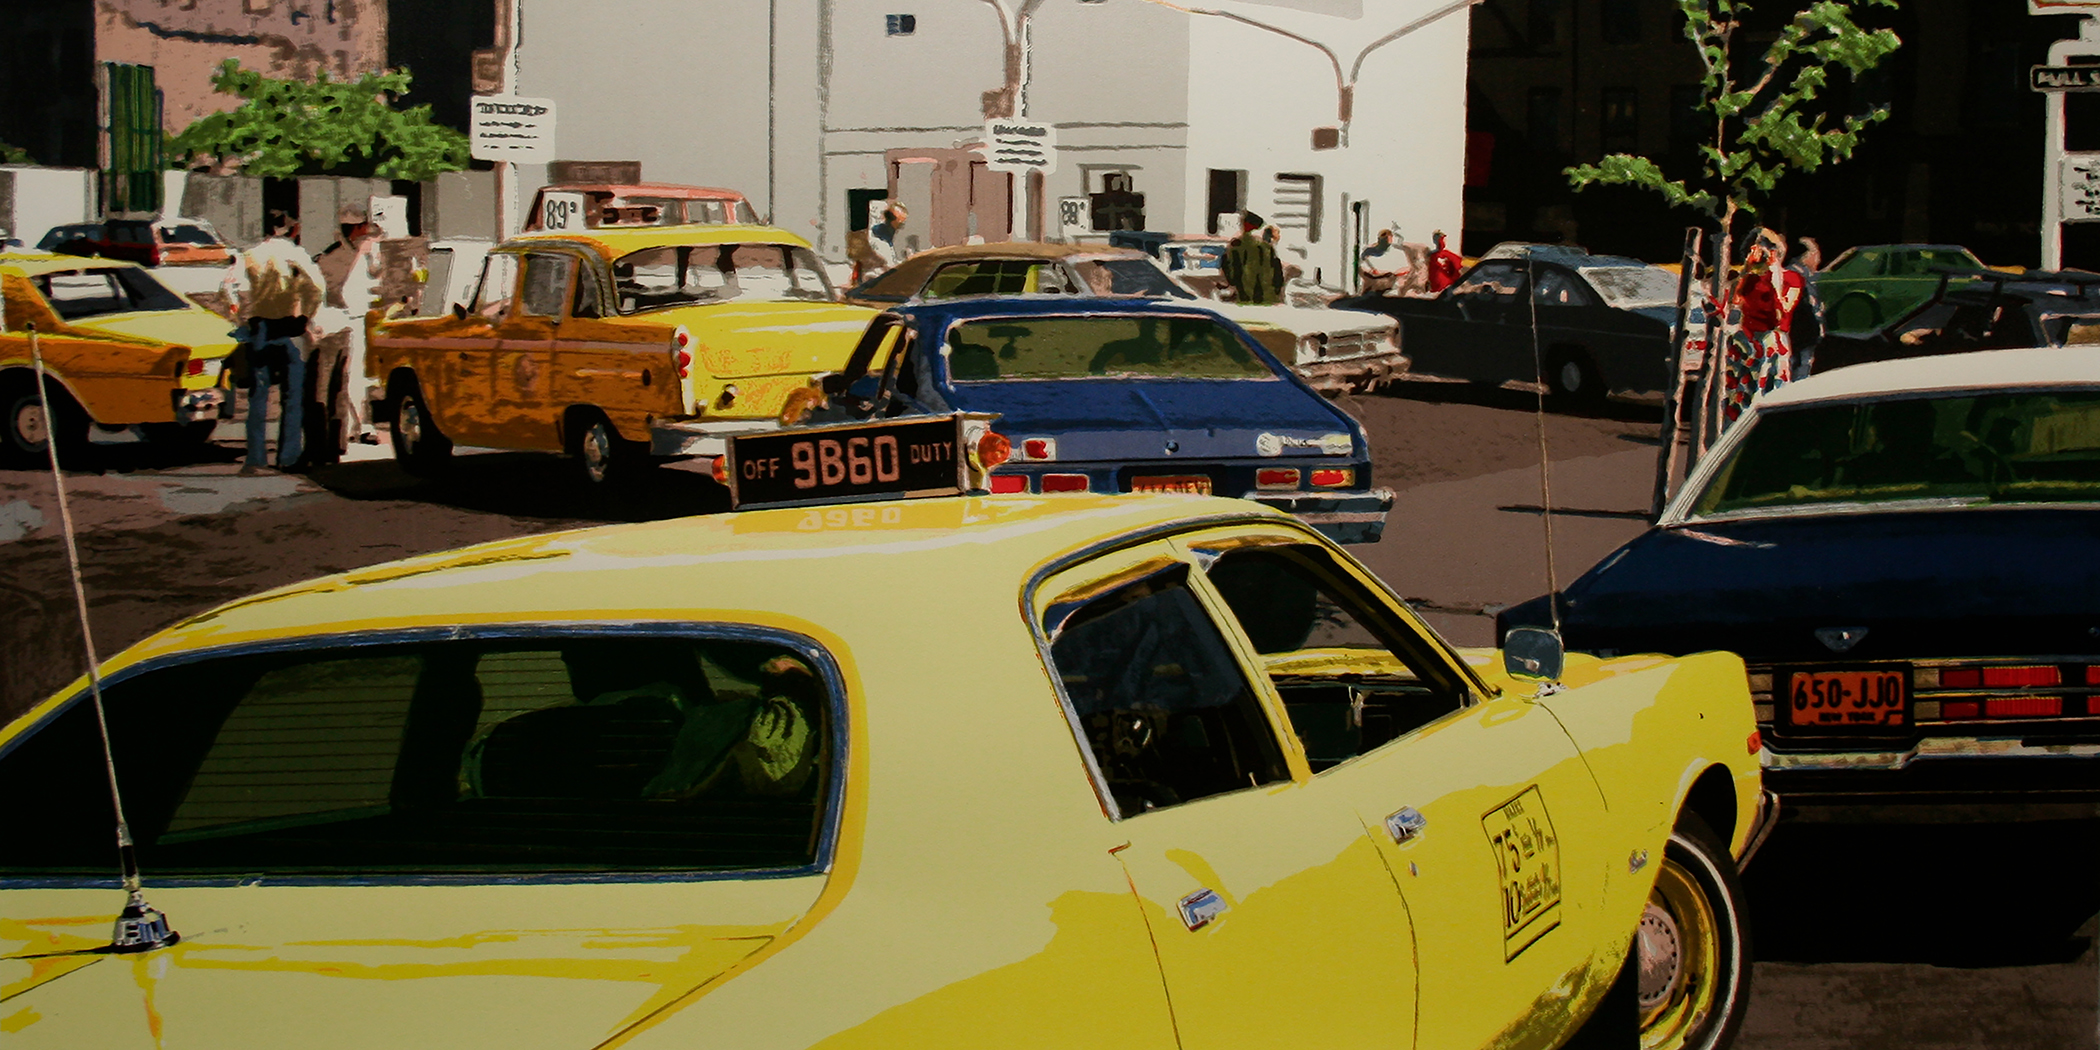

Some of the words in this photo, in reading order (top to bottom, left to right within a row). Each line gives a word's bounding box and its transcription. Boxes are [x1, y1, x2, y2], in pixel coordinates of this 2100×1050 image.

[743, 457, 780, 480] OFF
[791, 435, 900, 489] 9B60
[909, 441, 952, 464] DUTY
[1818, 712, 1842, 722] NEW
[1846, 712, 1876, 722] YORK
